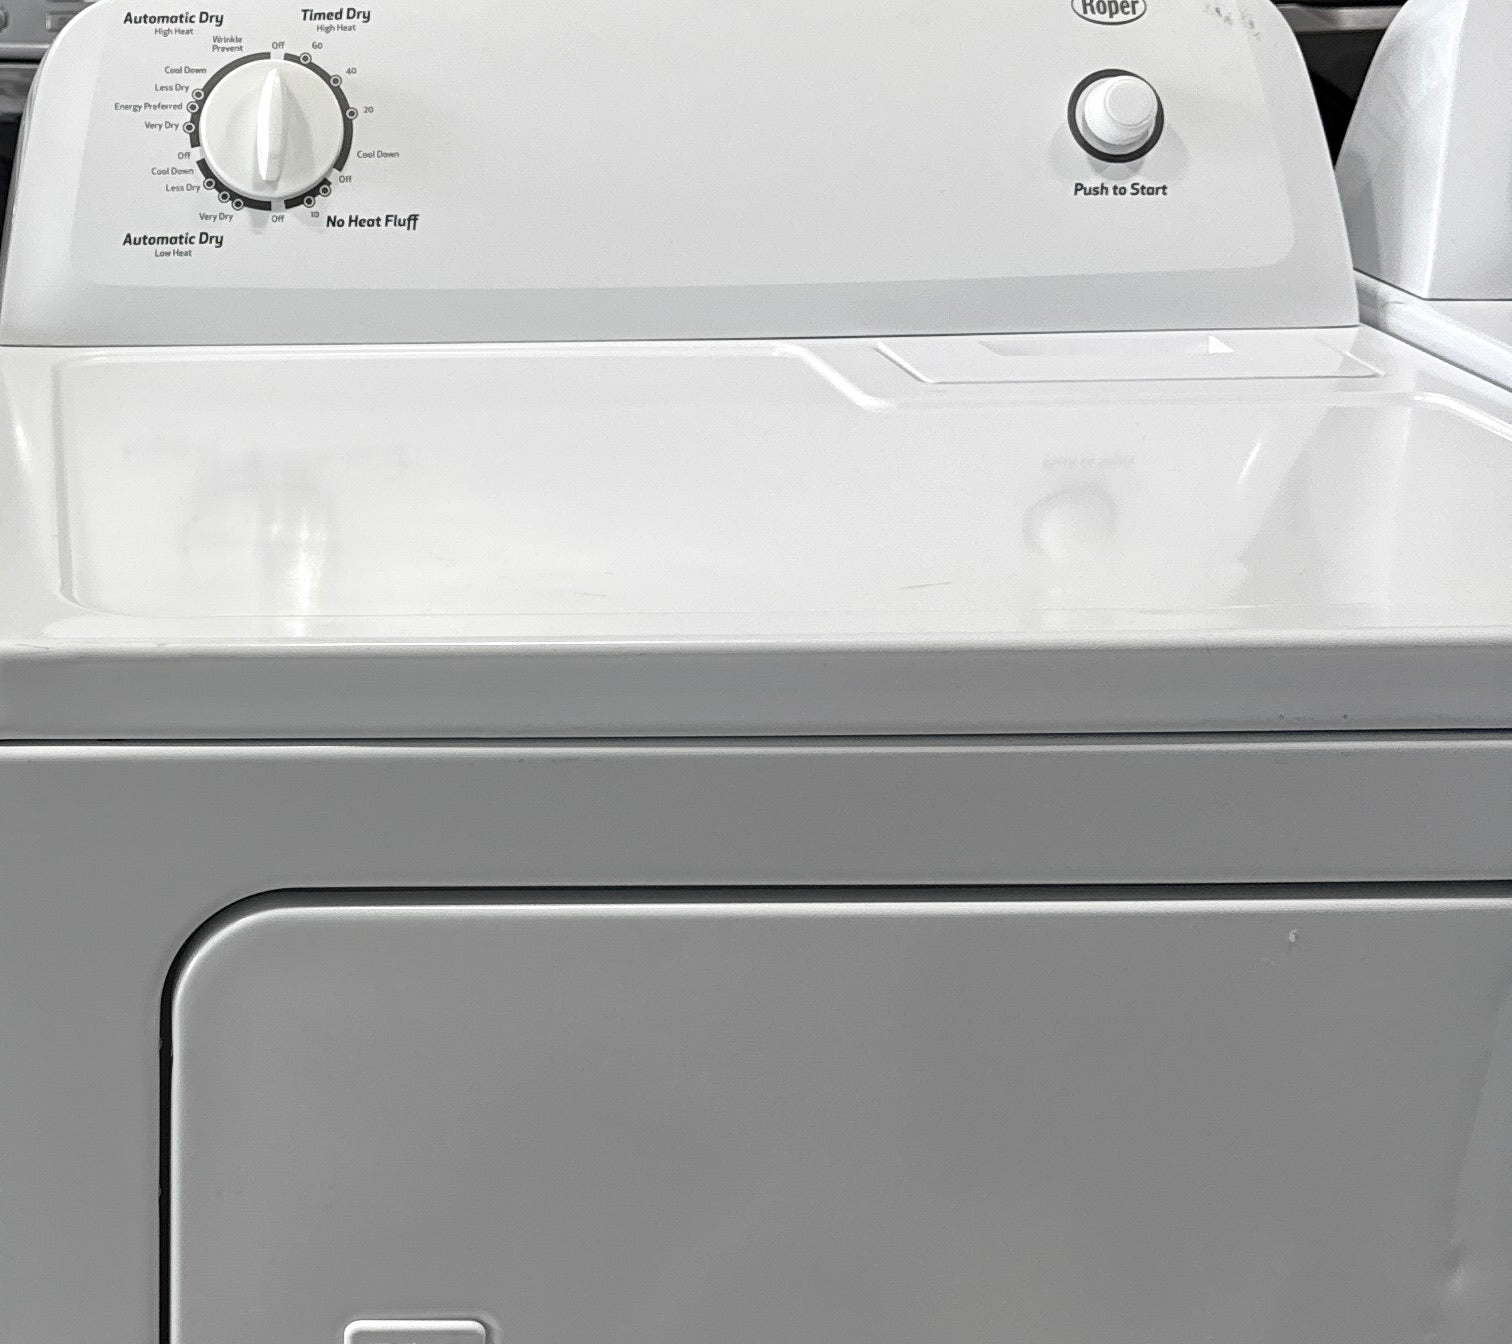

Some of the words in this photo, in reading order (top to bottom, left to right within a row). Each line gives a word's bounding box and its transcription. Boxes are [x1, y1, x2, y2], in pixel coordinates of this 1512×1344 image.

[123, 11, 196, 25] Automatic
[198, 11, 224, 27] Dry
[301, 8, 343, 22] Timed
[346, 8, 372, 24] Dry
[154, 28, 173, 37] High
[174, 27, 194, 36] Heat
[316, 24, 335, 34] High
[337, 23, 356, 32] Heat
[212, 35, 243, 44] Wrinkle
[212, 44, 244, 53] Prevent
[272, 41, 285, 50] Off
[312, 41, 323, 50] 60
[164, 67, 183, 75] Cool
[184, 66, 207, 75] Down
[346, 67, 357, 75] 40
[155, 83, 173, 92] Less
[174, 83, 190, 94] Dry
[114, 103, 142, 113] Energy
[144, 102, 183, 111] Preferred
[144, 121, 163, 132] Very
[165, 121, 179, 132] Dry
[178, 151, 191, 160] Off
[357, 150, 375, 159] Cool
[376, 150, 400, 159] Down
[151, 167, 169, 176] Cool
[171, 167, 194, 175] Down
[339, 175, 352, 184] Off
[165, 183, 184, 193] Less
[185, 183, 201, 194] Dry
[1074, 182, 1109, 196] Push
[1113, 184, 1126, 196] to
[1130, 182, 1168, 196] Start
[199, 212, 218, 223] Very
[219, 212, 233, 223] Dry
[271, 214, 285, 223] Off
[326, 215, 345, 228] No
[348, 214, 382, 228] Heat
[385, 213, 420, 231] Fluff
[122, 233, 196, 247] Automatic
[198, 232, 224, 248] Dry
[155, 248, 171, 257] Low
[173, 248, 192, 257] Heat
